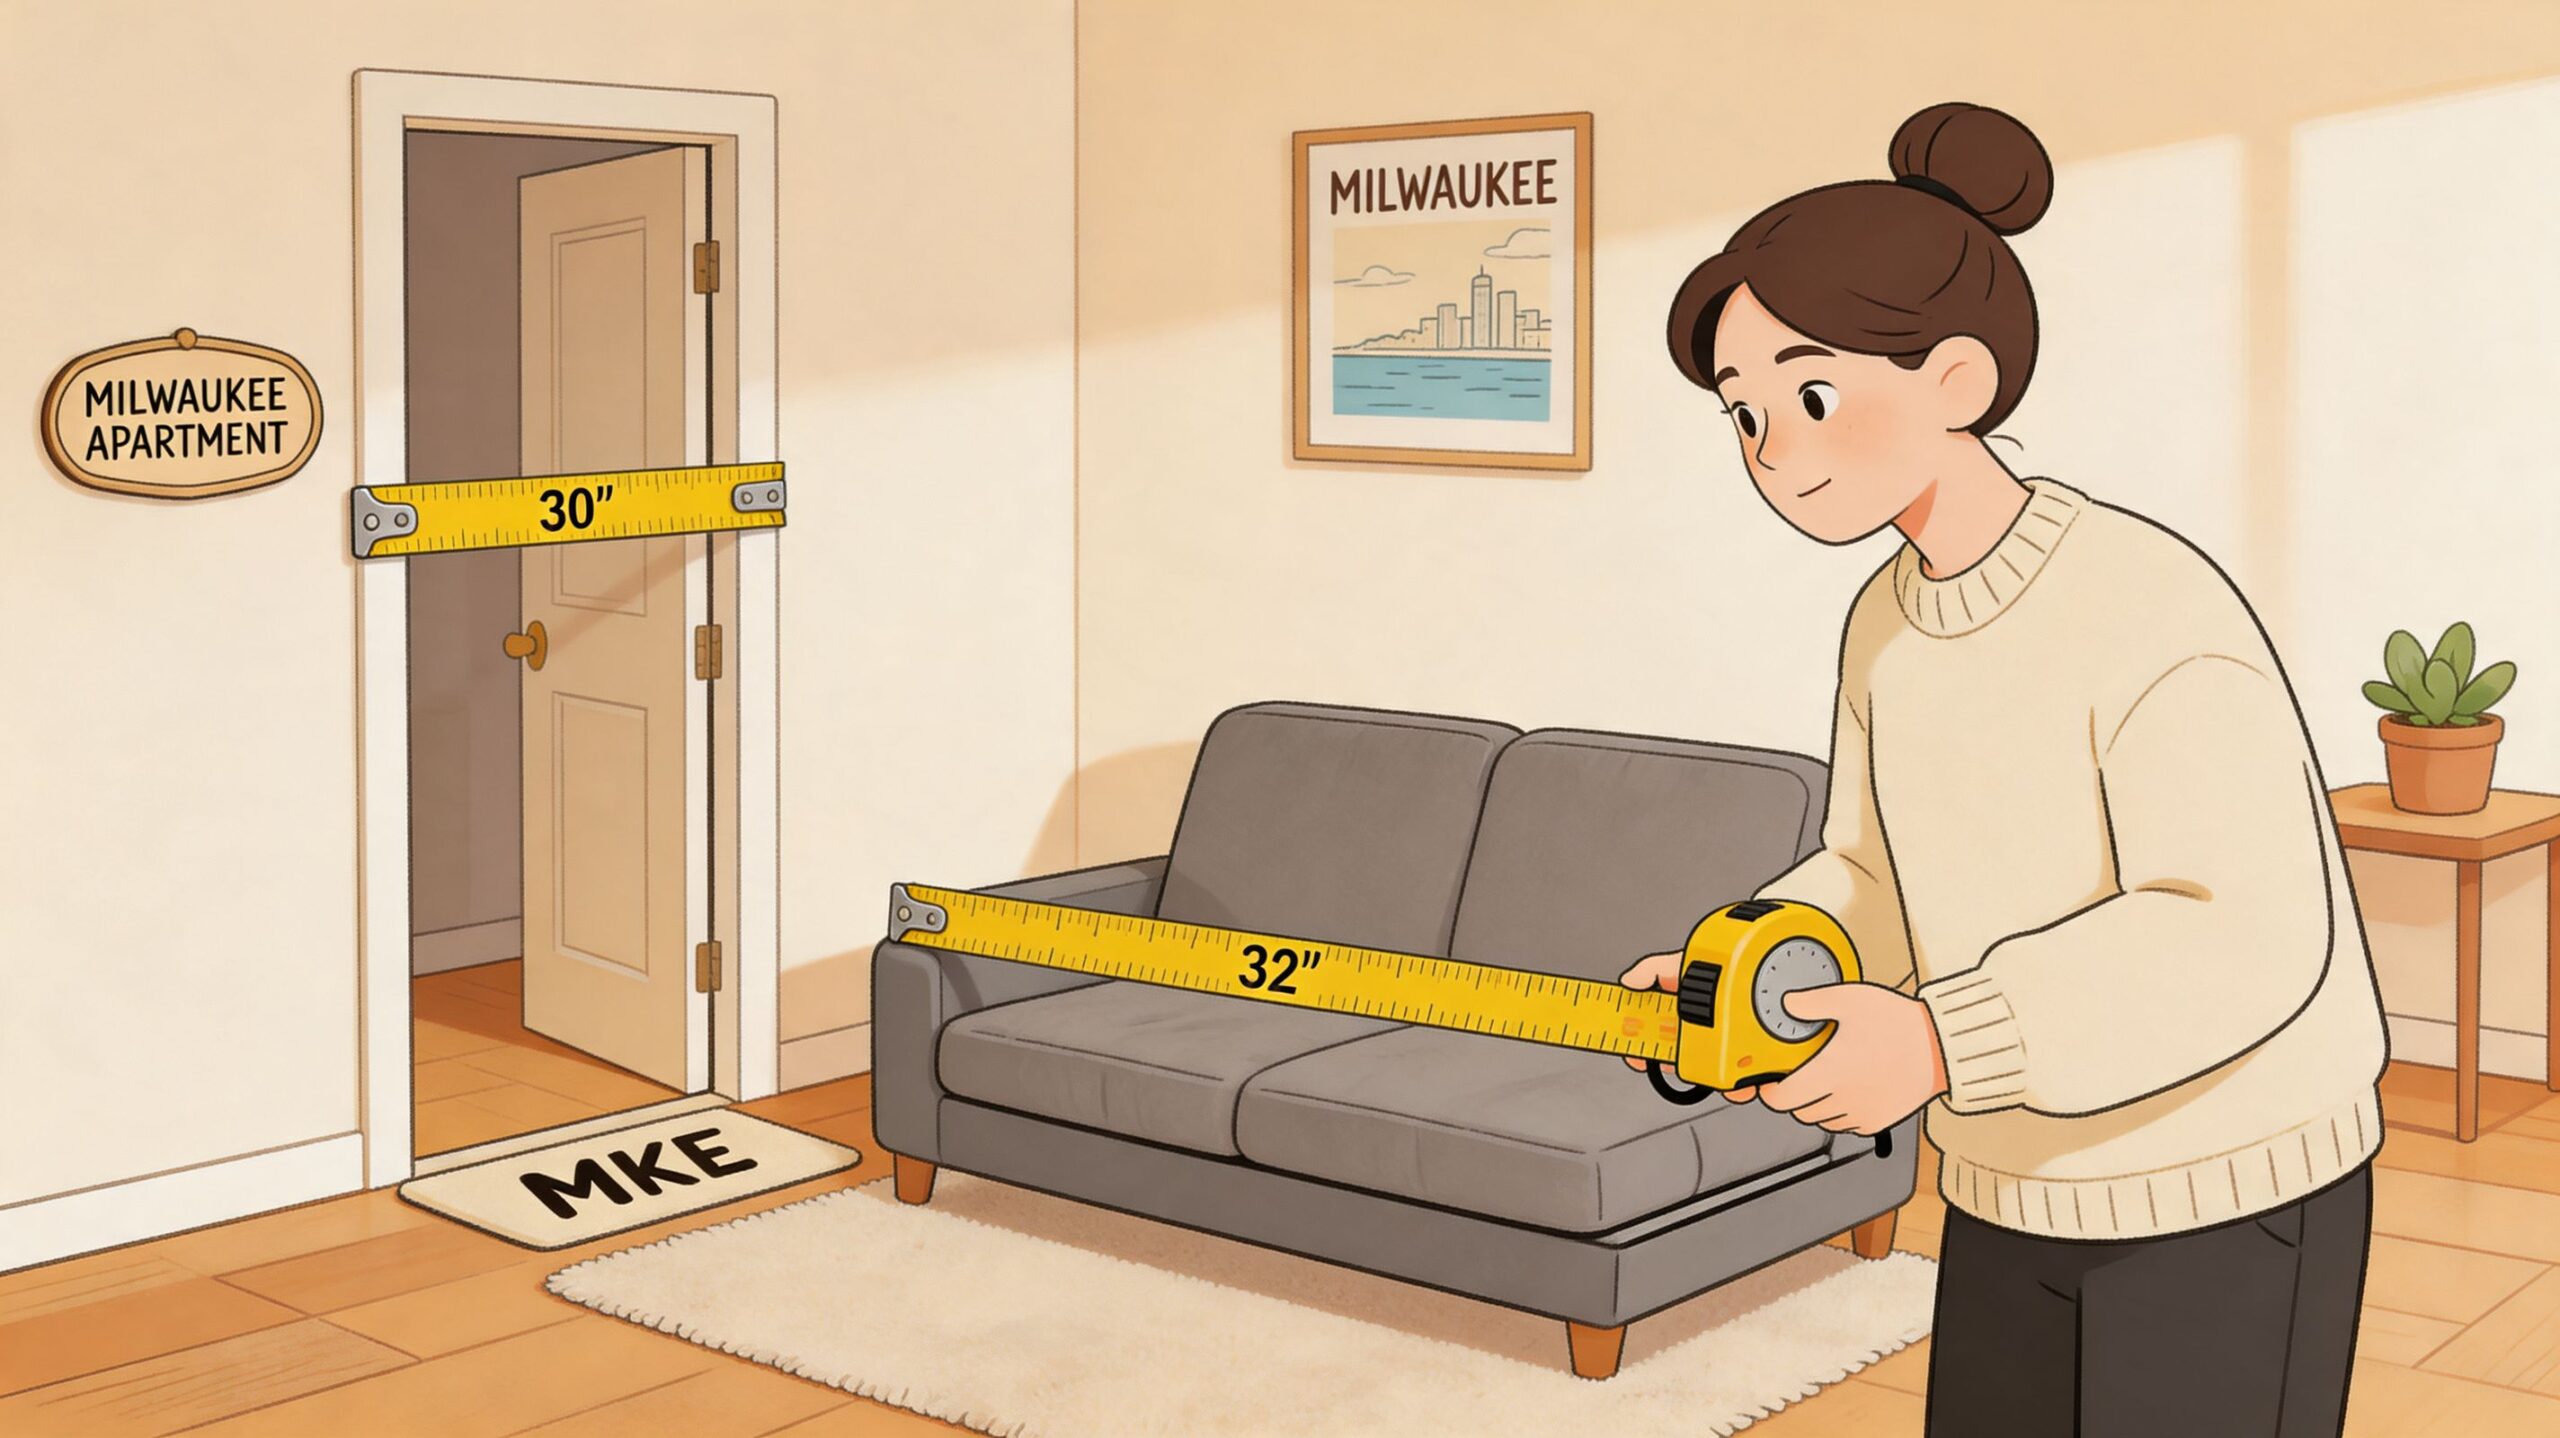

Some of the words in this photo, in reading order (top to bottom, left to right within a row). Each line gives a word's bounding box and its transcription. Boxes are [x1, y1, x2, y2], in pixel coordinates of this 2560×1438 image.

[1330, 158, 1558, 215] MILWAUKEE
[84, 376, 288, 418] MILWAUKEE
[84, 420, 290, 462] APARTMENT
[538, 484, 614, 533] 30"
[1237, 943, 1323, 996] 32"
[518, 1126, 760, 1221] MKE
